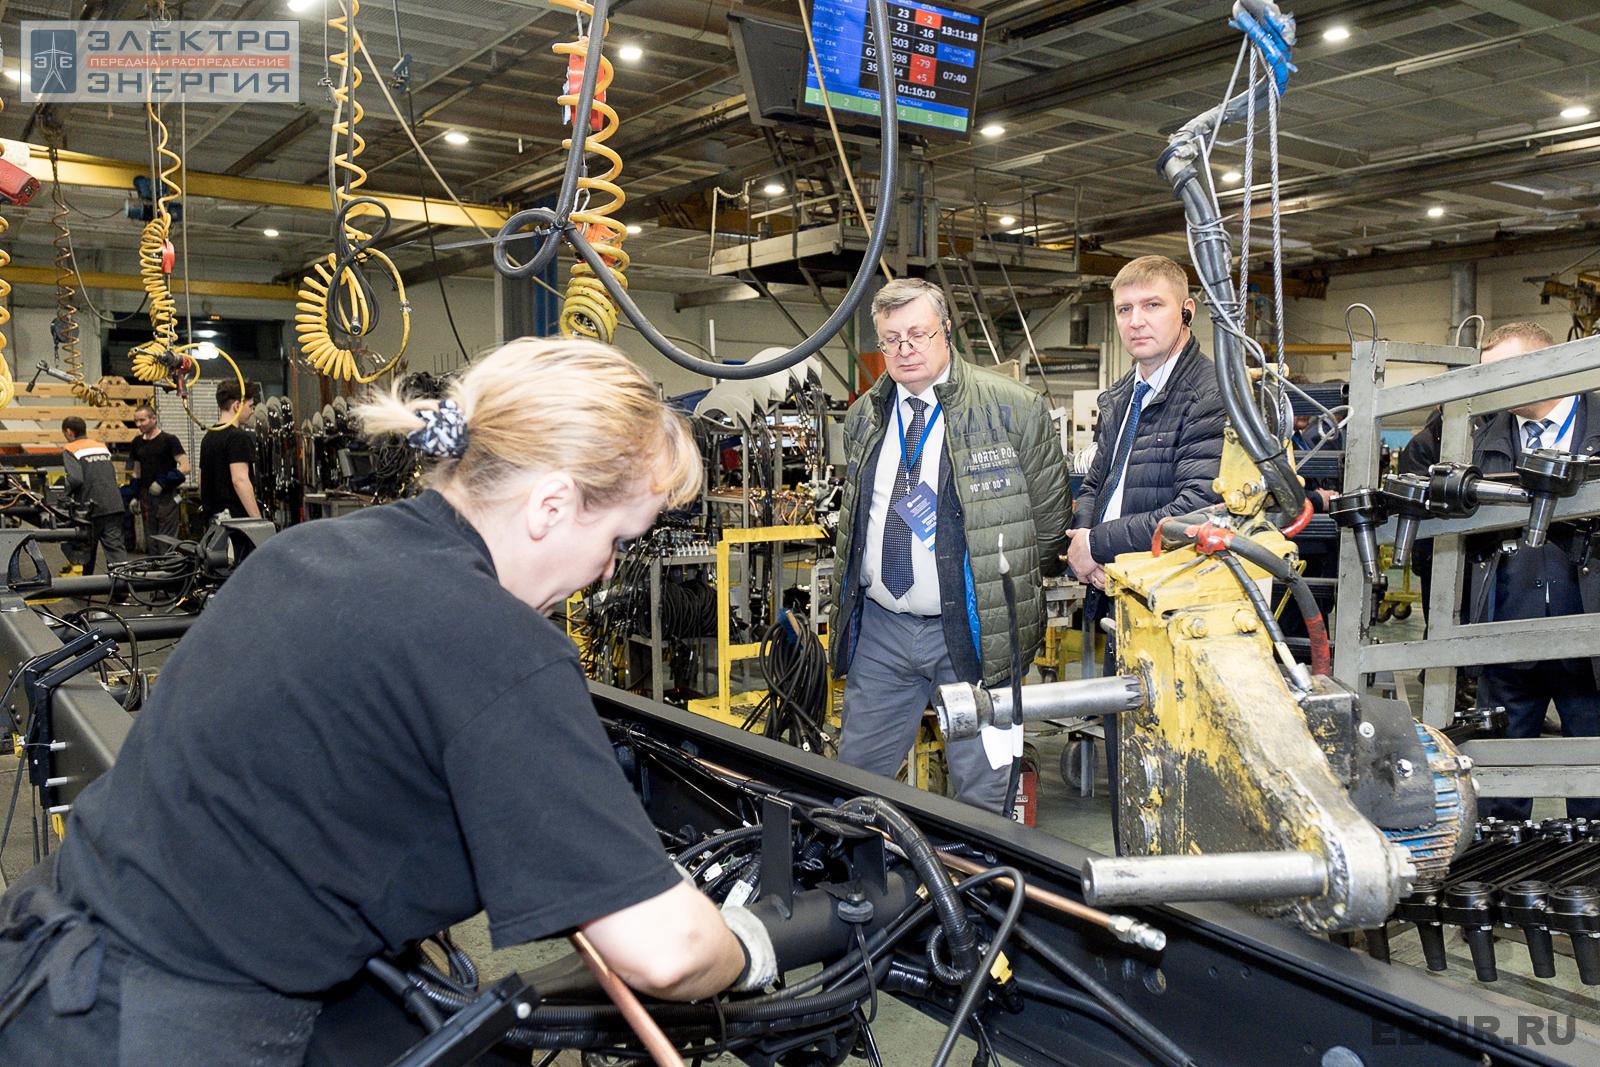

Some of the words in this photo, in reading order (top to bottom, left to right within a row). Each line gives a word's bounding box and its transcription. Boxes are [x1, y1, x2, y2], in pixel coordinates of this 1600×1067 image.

[897, 8, 910, 19] 23
[923, 15, 934, 25] -2
[896, 22, 909, 33] 23
[919, 28, 935, 39] -16
[941, 25, 979, 42] 13:11:18
[892, 37, 909, 49] 503
[915, 43, 936, 55] -283
[917, 59, 931, 69] -79
[916, 73, 928, 82] +5
[942, 71, 968, 84] 07:40
[897, 84, 937, 99] 01:10:10
[843, 98, 850, 107] 2
[872, 103, 879, 112] 3
[926, 113, 933, 122] 5
[953, 118, 960, 128] 6
[971, 449, 1000, 464] NORTH
